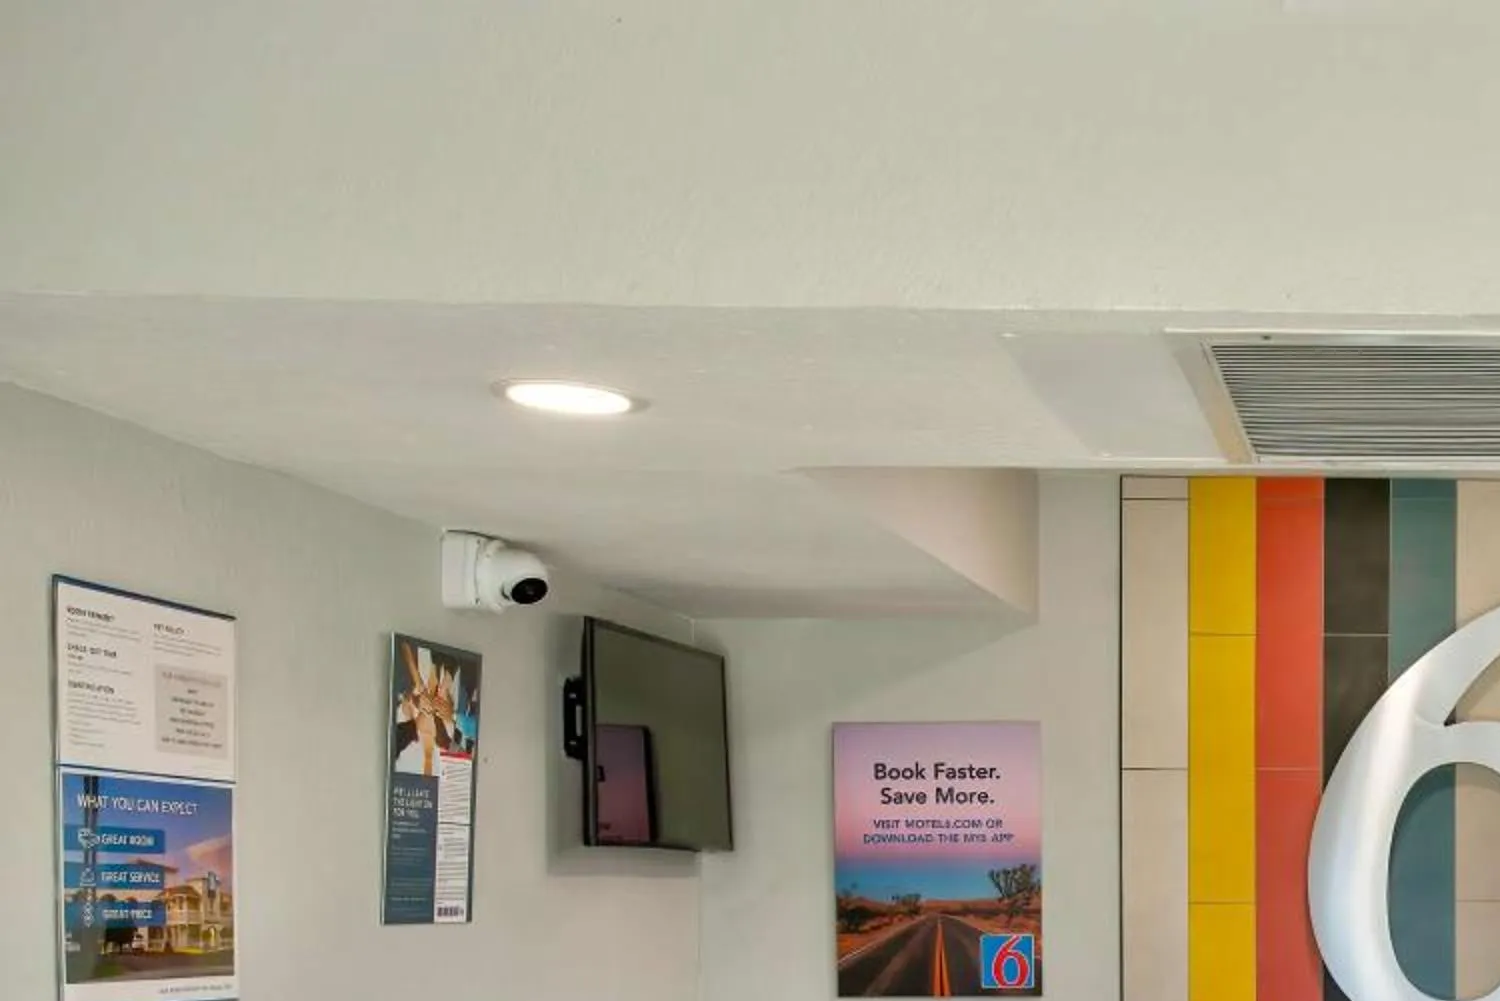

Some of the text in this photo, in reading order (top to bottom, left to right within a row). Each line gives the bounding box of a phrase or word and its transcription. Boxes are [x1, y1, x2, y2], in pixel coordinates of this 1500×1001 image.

[873, 762, 1001, 780] Book Faster.
[77, 793, 199, 815] WHAT YOU CAN EXPECT
[880, 788, 995, 805] Save More.
[873, 819, 900, 829] VISIT
[863, 833, 933, 844] DOWNLOAD
[937, 833, 958, 843] THE
[991, 934, 1030, 988] 6
